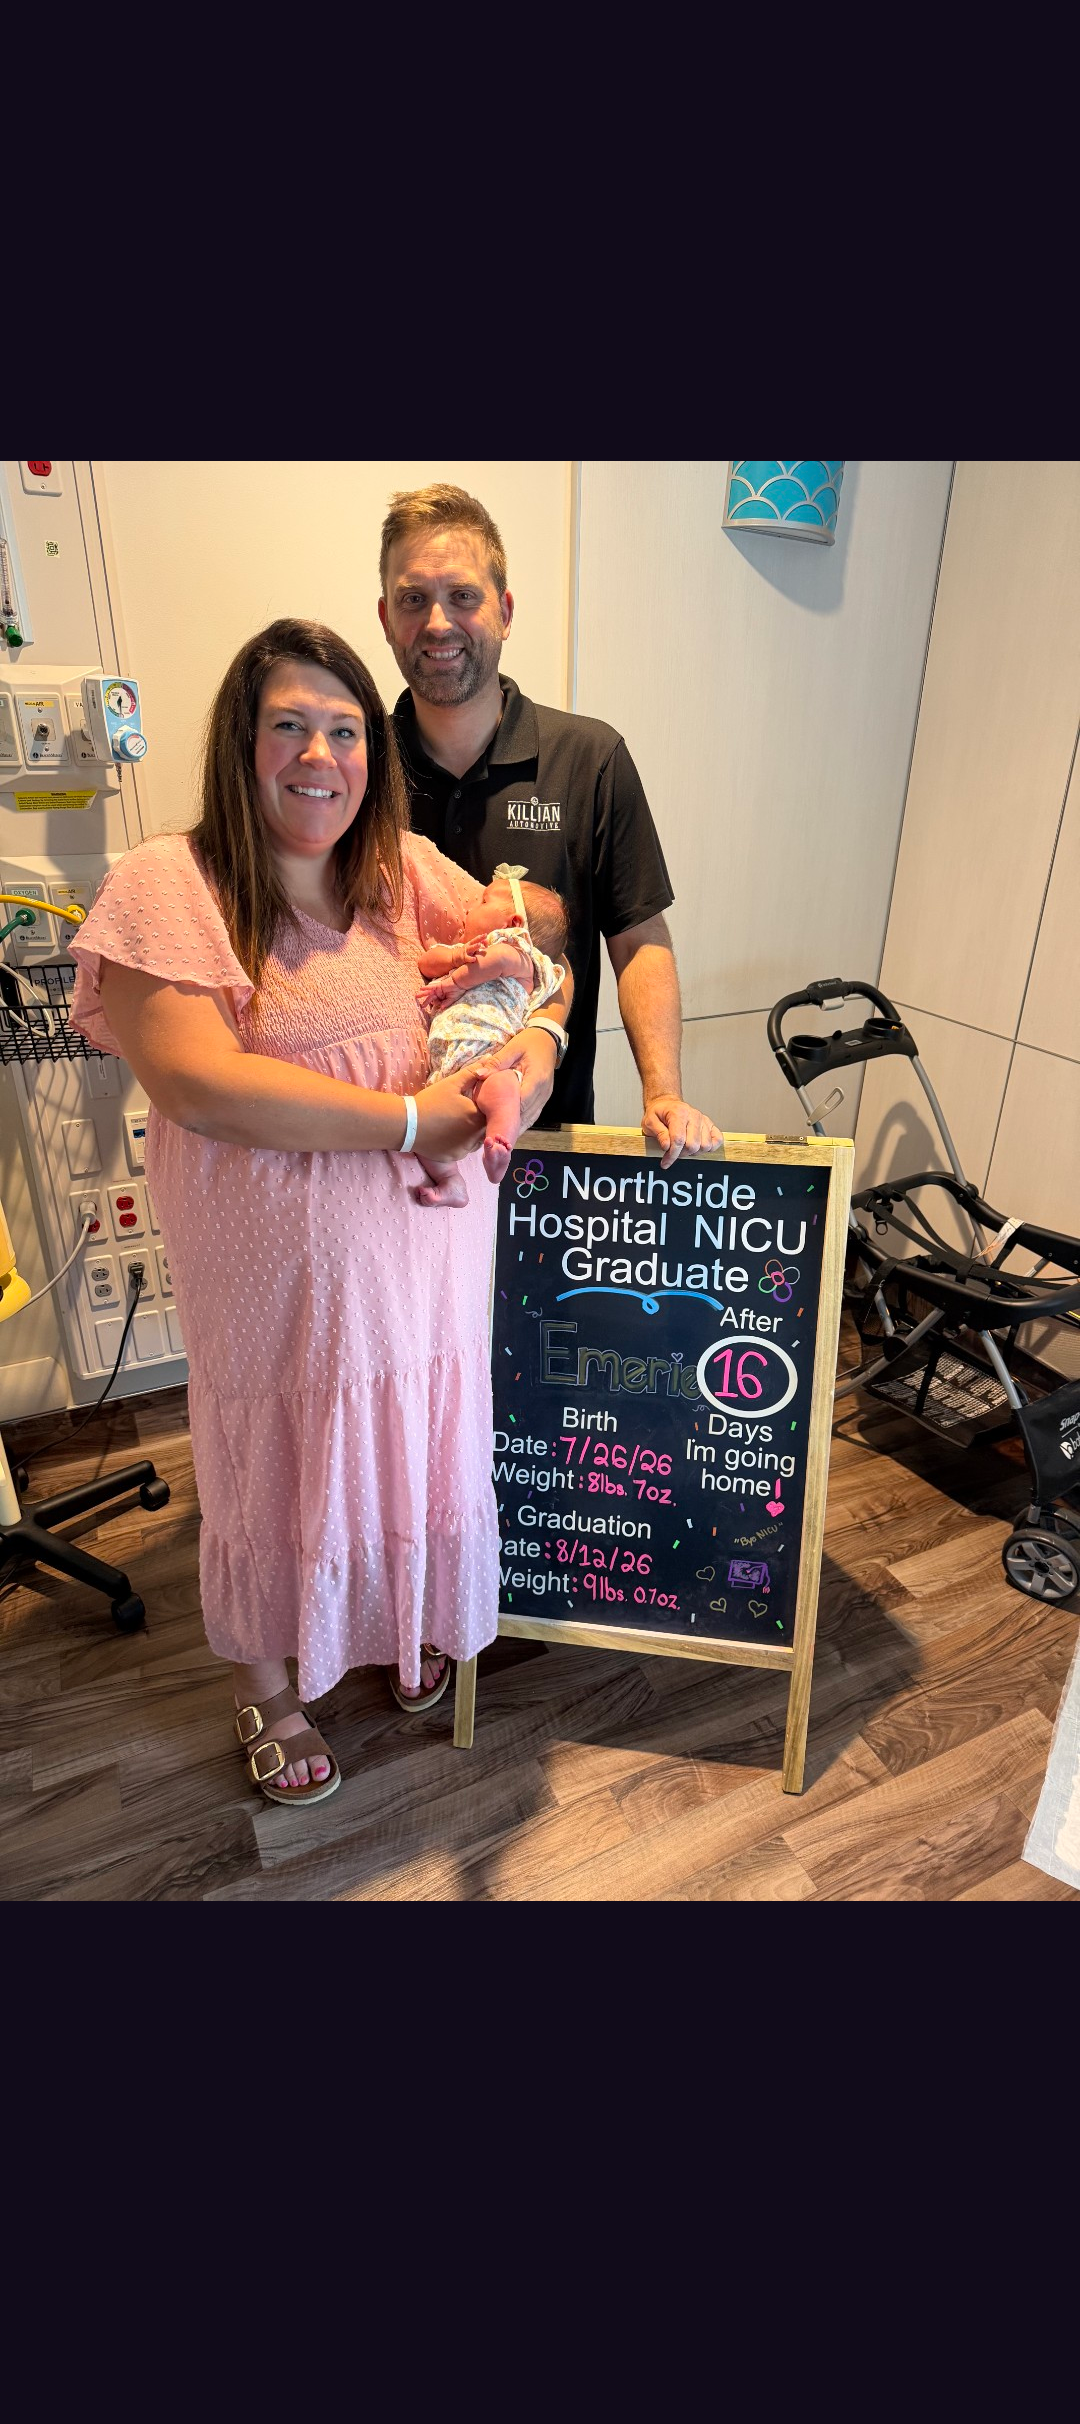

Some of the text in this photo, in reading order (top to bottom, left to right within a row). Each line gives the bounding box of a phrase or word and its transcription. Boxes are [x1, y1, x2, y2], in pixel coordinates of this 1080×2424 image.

[508, 804, 560, 822] KILLIAN
[34, 976, 75, 986] PROFLE
[562, 1165, 756, 1211] Northside
[509, 1203, 807, 1255] Hospital NICU
[561, 1246, 750, 1293] Graduate
[719, 1306, 783, 1333] After
[713, 1348, 768, 1400] 16
[562, 1406, 618, 1432] Birth
[708, 1413, 773, 1445] Days
[560, 1435, 673, 1476] 7/26/26
[686, 1438, 796, 1478] I'm going
[633, 1479, 677, 1508] 7oz.
[517, 1504, 652, 1540] Graduation
[556, 1538, 653, 1575] 8/12/26
